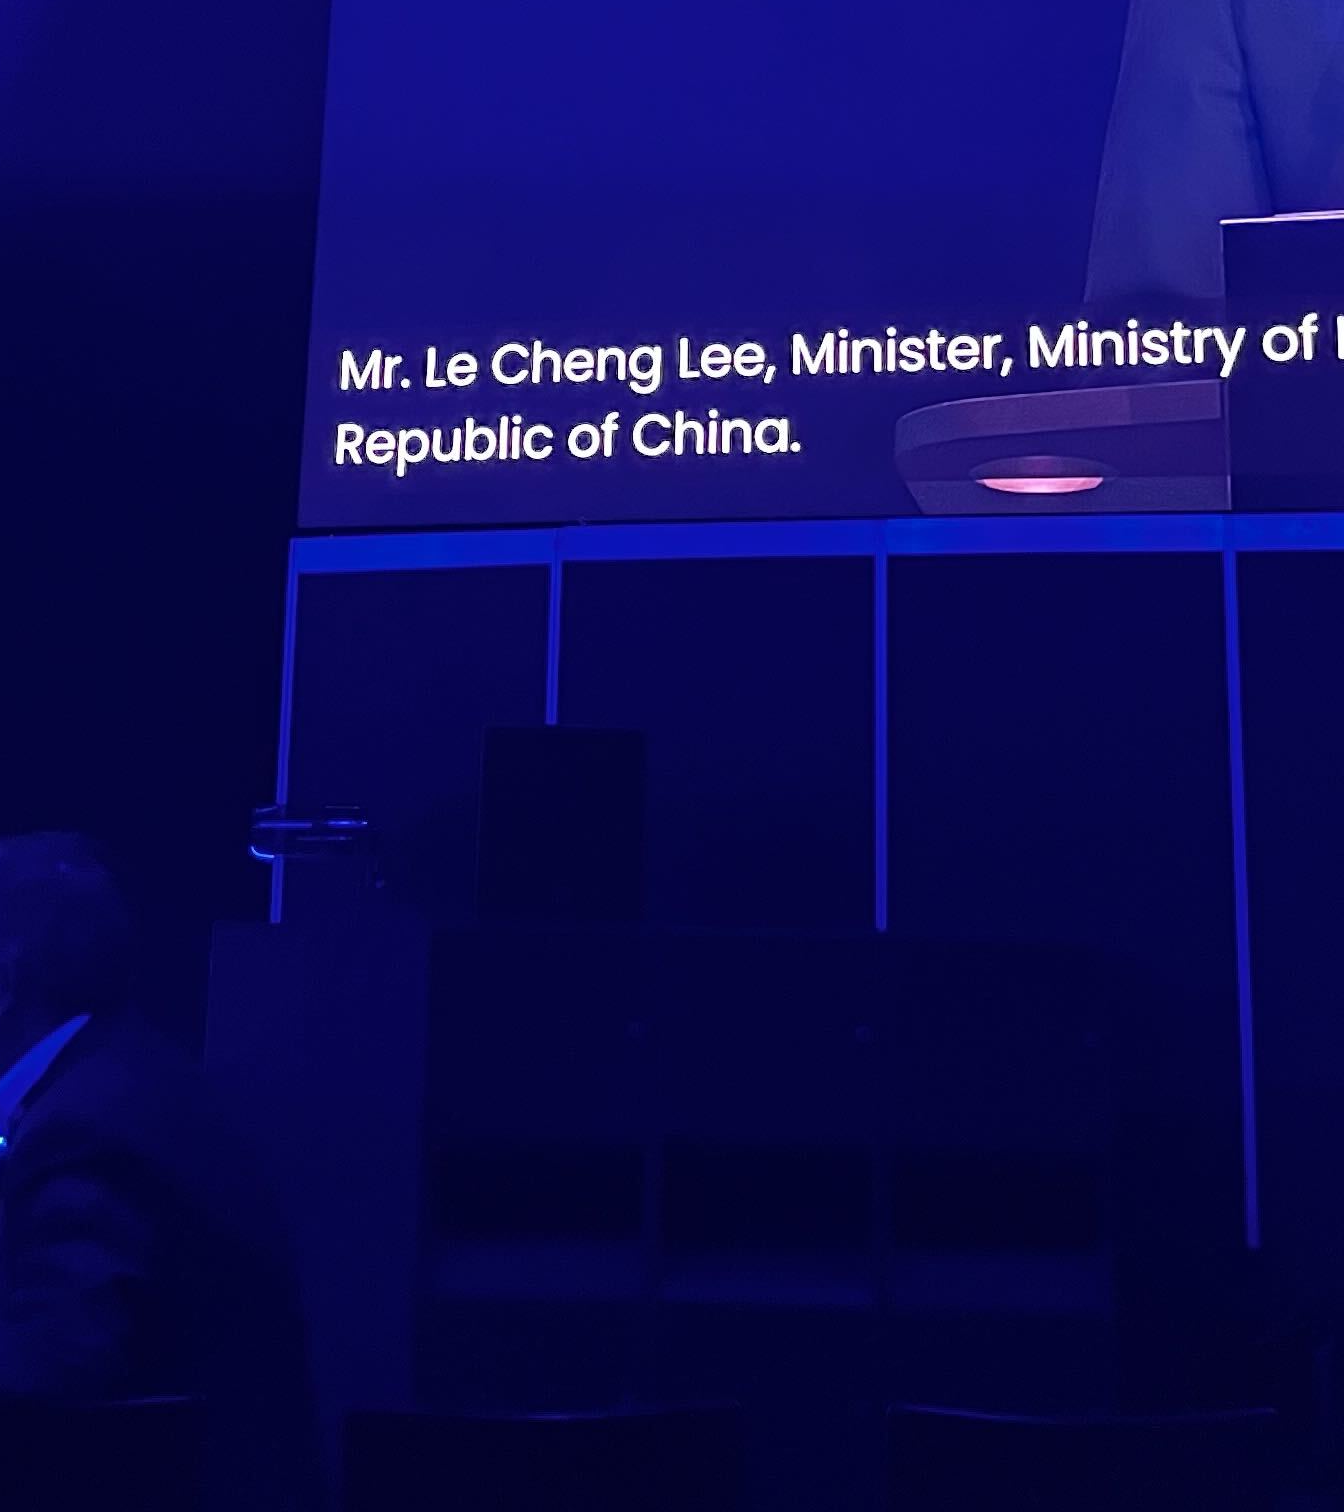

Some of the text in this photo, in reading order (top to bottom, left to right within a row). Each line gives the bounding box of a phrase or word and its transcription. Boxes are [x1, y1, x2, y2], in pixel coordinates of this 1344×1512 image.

[339, 348, 412, 391] Mr.
[424, 345, 479, 389] Le
[490, 339, 663, 396] Cheng
[678, 336, 777, 385] Lee,
[791, 326, 1014, 378] Minister,
[1028, 317, 1248, 379] Ministry
[1261, 311, 1320, 363] of
[334, 407, 802, 479] Republic of China.
